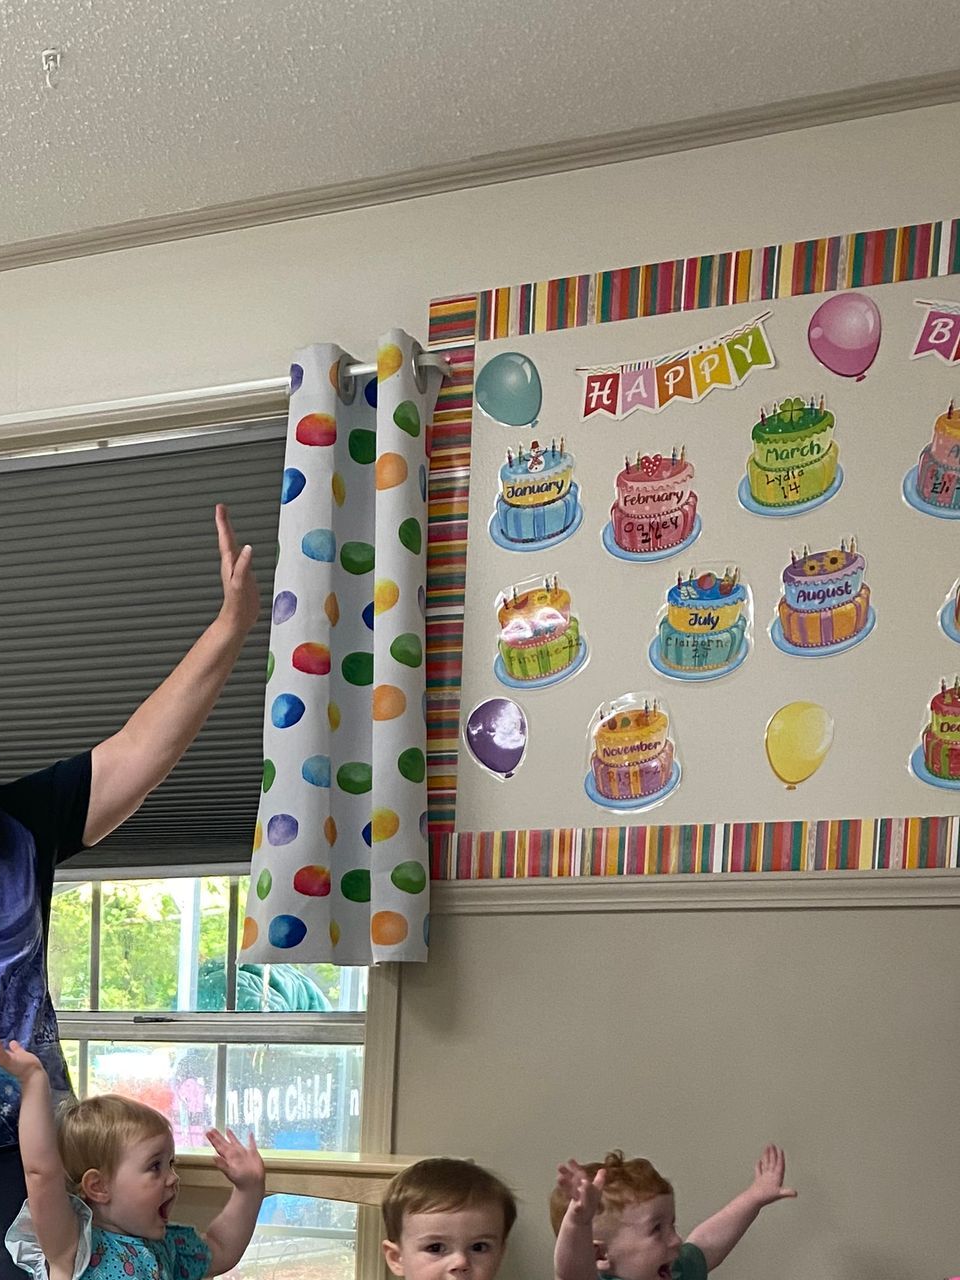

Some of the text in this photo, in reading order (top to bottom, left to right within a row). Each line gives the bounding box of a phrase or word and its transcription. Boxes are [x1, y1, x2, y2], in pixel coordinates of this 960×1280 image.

[589, 334, 753, 409] HAPPY
[766, 440, 821, 463] March
[766, 469, 805, 487] Lydia
[506, 479, 564, 499] January
[623, 490, 684, 507] February
[781, 482, 800, 499] 14
[797, 584, 852, 605] August
[689, 613, 719, 630] July
[603, 741, 661, 758] November
[266, 1086, 280, 1121] a
